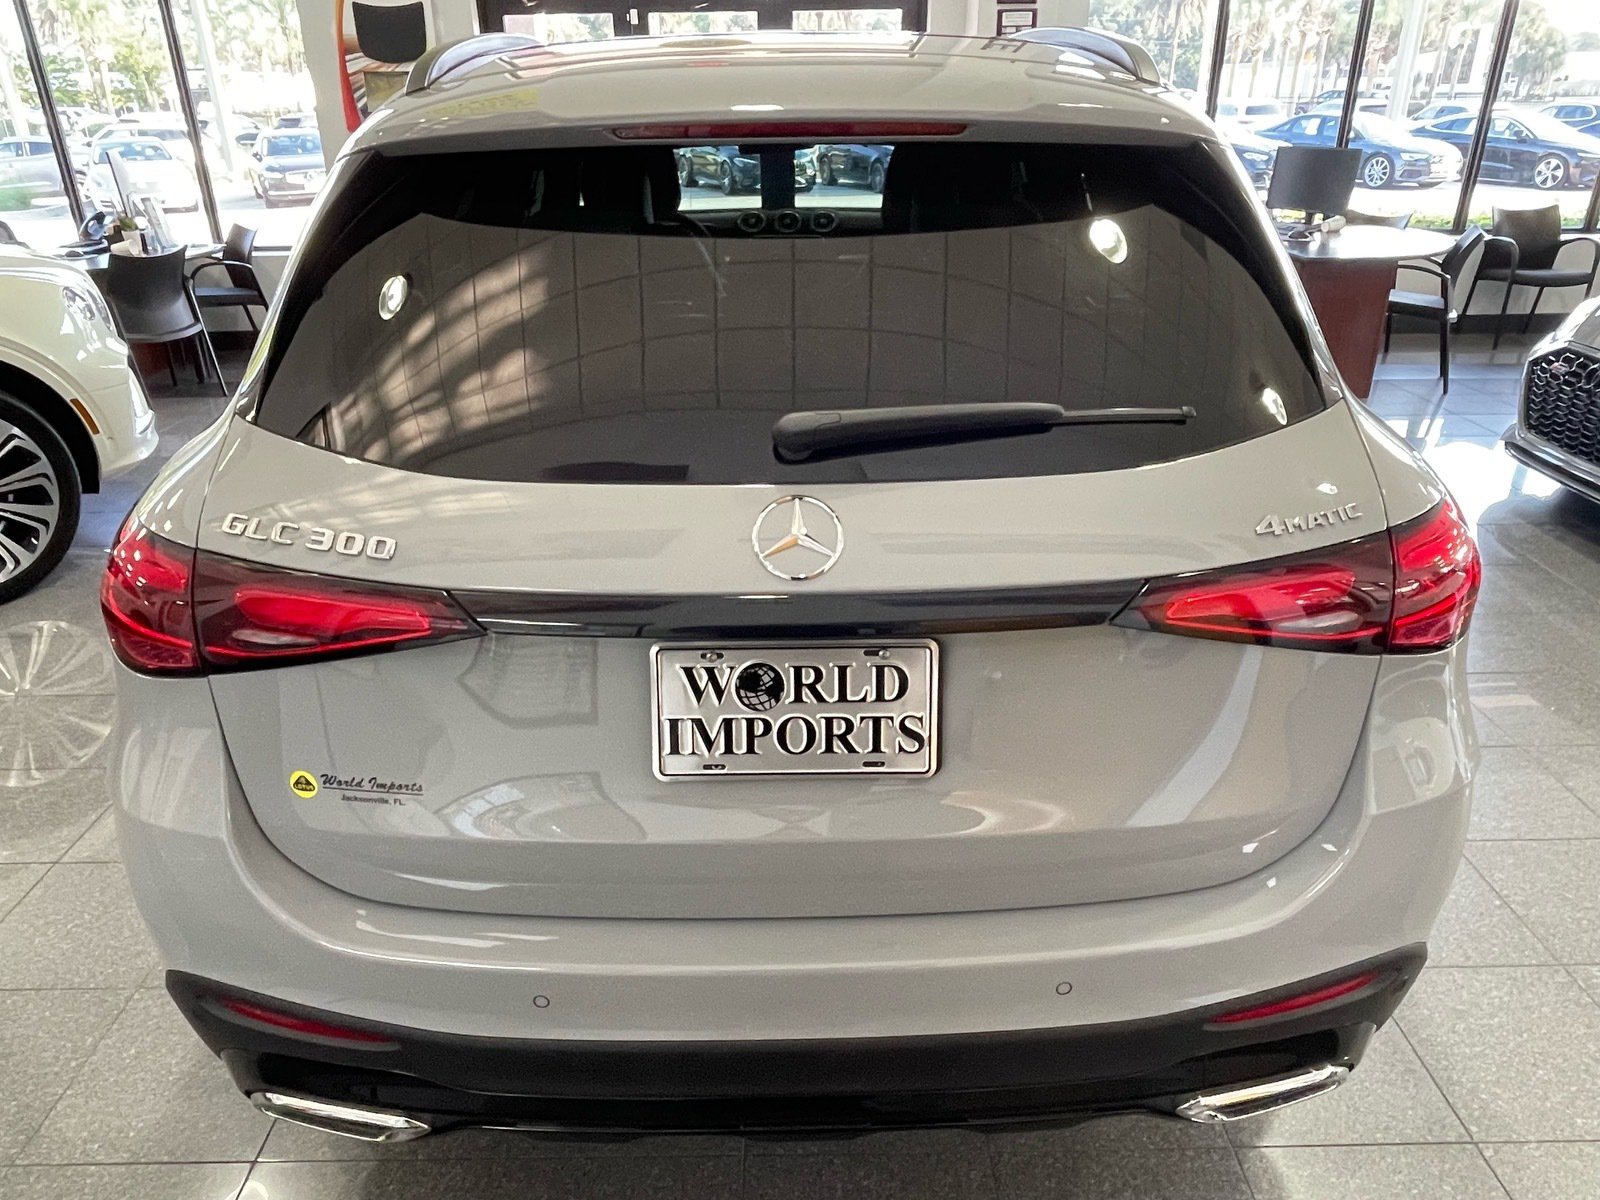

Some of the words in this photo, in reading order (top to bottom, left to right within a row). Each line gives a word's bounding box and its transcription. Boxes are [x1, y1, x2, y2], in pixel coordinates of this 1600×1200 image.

[221, 512, 299, 545] GLC
[304, 527, 397, 560] 300
[1255, 502, 1363, 536] 4MATIC
[679, 662, 909, 711] WORLD
[663, 714, 926, 757] IMPORTS
[320, 773, 365, 789] World
[368, 776, 423, 793] Imports
